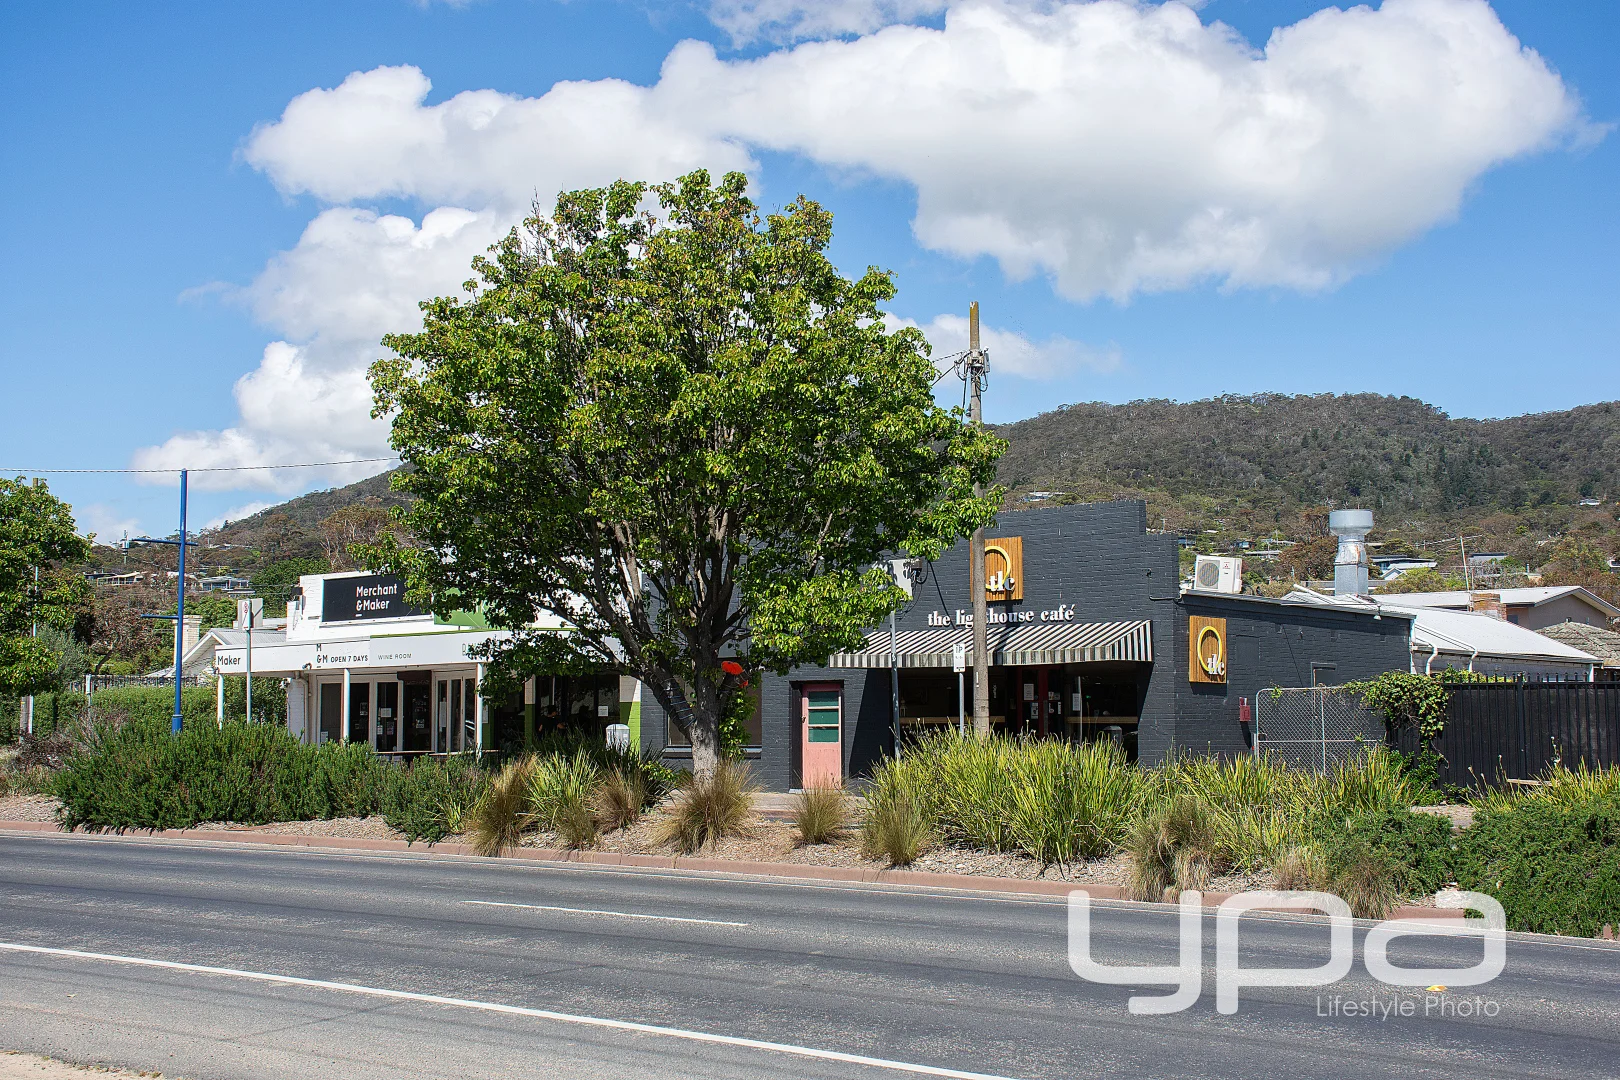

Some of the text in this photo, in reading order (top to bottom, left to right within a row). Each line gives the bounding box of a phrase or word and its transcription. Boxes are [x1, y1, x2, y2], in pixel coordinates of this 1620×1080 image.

[356, 583, 397, 597] Merchant
[928, 604, 1075, 628] the lighouse café
[217, 654, 241, 666] Maker
[347, 655, 352, 663] 7
[353, 654, 369, 662] DAYS
